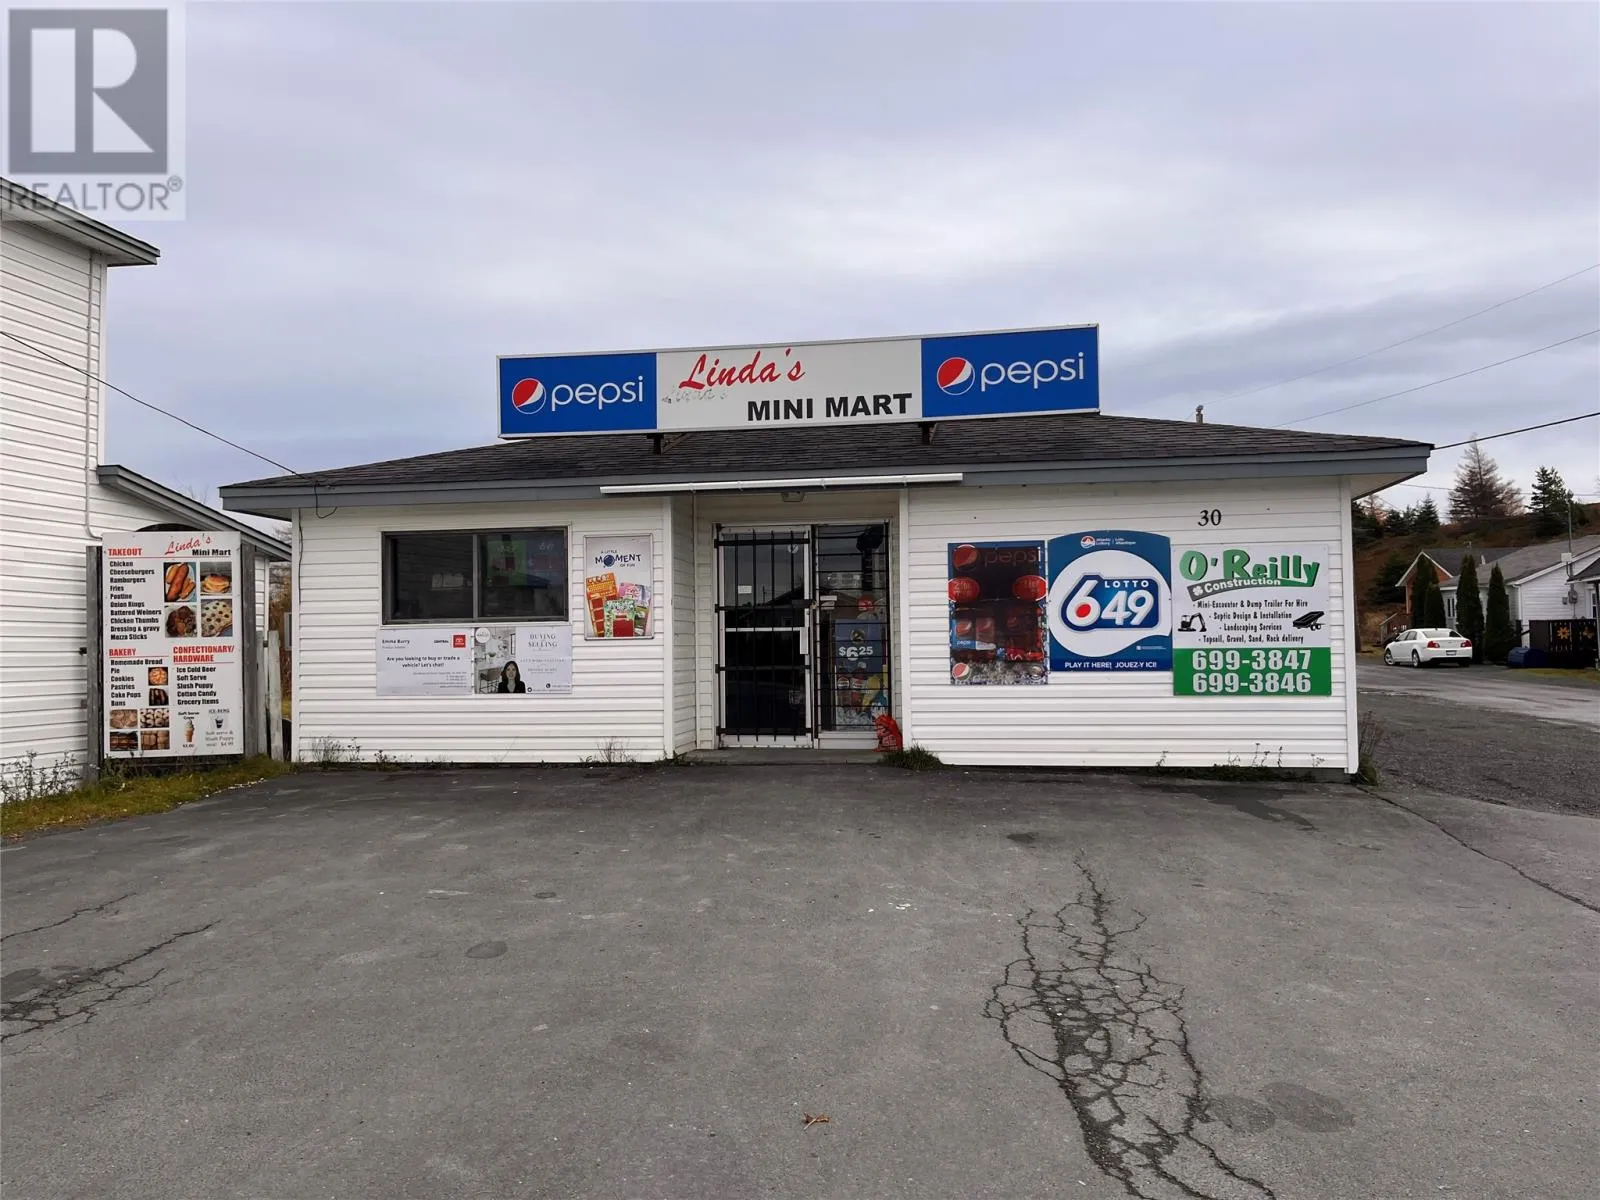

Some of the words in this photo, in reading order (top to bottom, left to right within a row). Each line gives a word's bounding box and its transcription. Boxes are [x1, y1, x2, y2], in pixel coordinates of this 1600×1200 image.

[678, 347, 805, 390] Linda's
[981, 352, 1084, 392] pepsi
[551, 375, 643, 412] pepsi
[748, 398, 813, 421] MINI
[825, 393, 912, 418] MART
[1197, 509, 1221, 526] 30
[164, 533, 211, 555] Linda's
[108, 548, 142, 556] TAKEOUT
[984, 547, 1041, 568] pepsi
[595, 553, 641, 567] MOMENT
[1179, 549, 1320, 586] O'Reilly
[1104, 580, 1149, 589] LOTTO
[1204, 579, 1281, 593] Construction
[1197, 600, 1238, 609] Mini-Excavator
[1240, 600, 1245, 608] &
[1246, 600, 1262, 609] Dump
[1264, 599, 1283, 608] Trailer
[1284, 599, 1294, 608] For
[1296, 599, 1308, 607] Hire
[1213, 612, 1231, 621] Septic
[1233, 612, 1251, 621] Design
[1260, 611, 1292, 619] Installation
[1223, 623, 1257, 633] Landscaping
[1260, 623, 1282, 631] Services
[1203, 635, 1225, 644] Topsoil,
[1226, 635, 1246, 644] Gravel,
[1249, 635, 1264, 643] Sand,
[1282, 634, 1304, 644] delivery
[109, 648, 136, 656] BAKERY
[173, 645, 235, 654] CONFECTIONARY/
[173, 654, 214, 663] HARDWARE
[1064, 661, 1081, 669] PLAY
[1083, 661, 1090, 669] IT
[1091, 661, 1112, 669] HERE!
[1115, 661, 1144, 669] JOUEZ-Y
[1192, 649, 1311, 670] 699-3847
[1192, 672, 1311, 693] 699-3846
